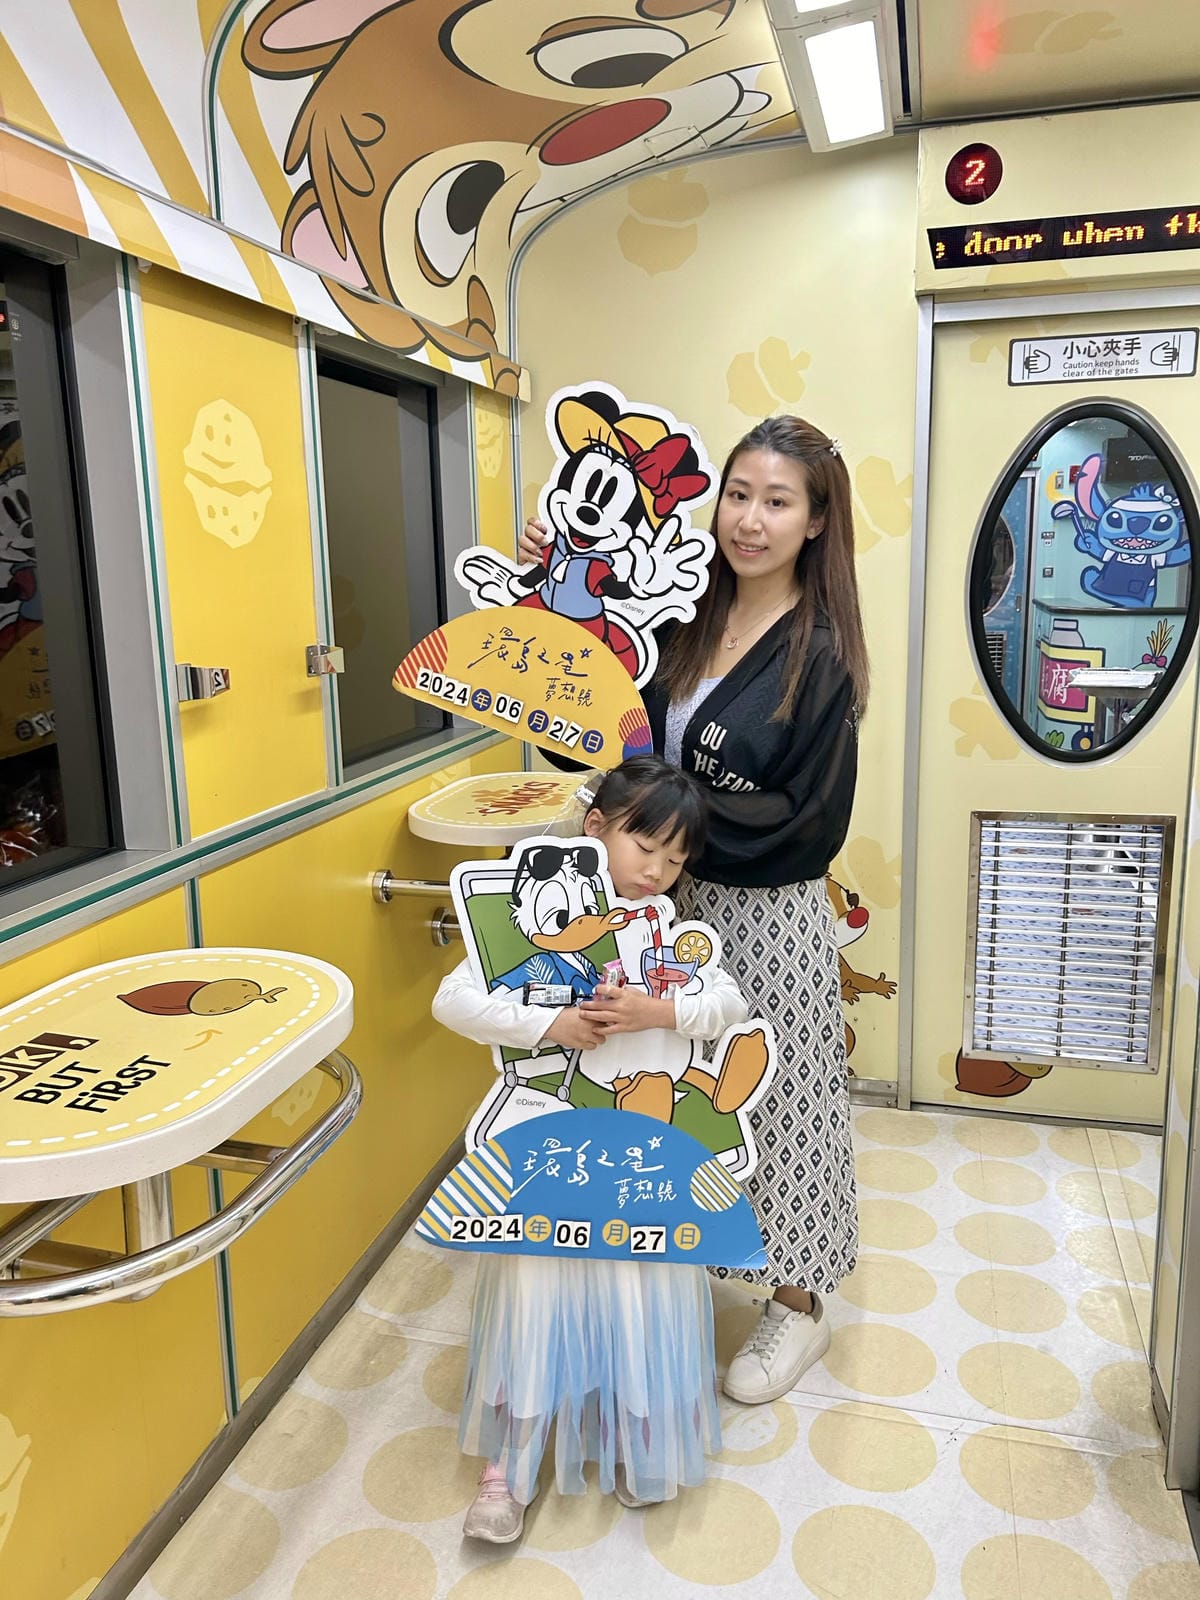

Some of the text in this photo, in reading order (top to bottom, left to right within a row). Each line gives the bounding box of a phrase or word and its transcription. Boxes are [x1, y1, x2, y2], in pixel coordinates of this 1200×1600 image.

[965, 160, 985, 186] 2
[1062, 221, 1145, 247] when
[1062, 337, 1142, 360] 小心夾手
[1062, 358, 1140, 370] Caution keep hands
[1062, 366, 1139, 378] clear of the gates
[13, 1061, 102, 1105] BUT
